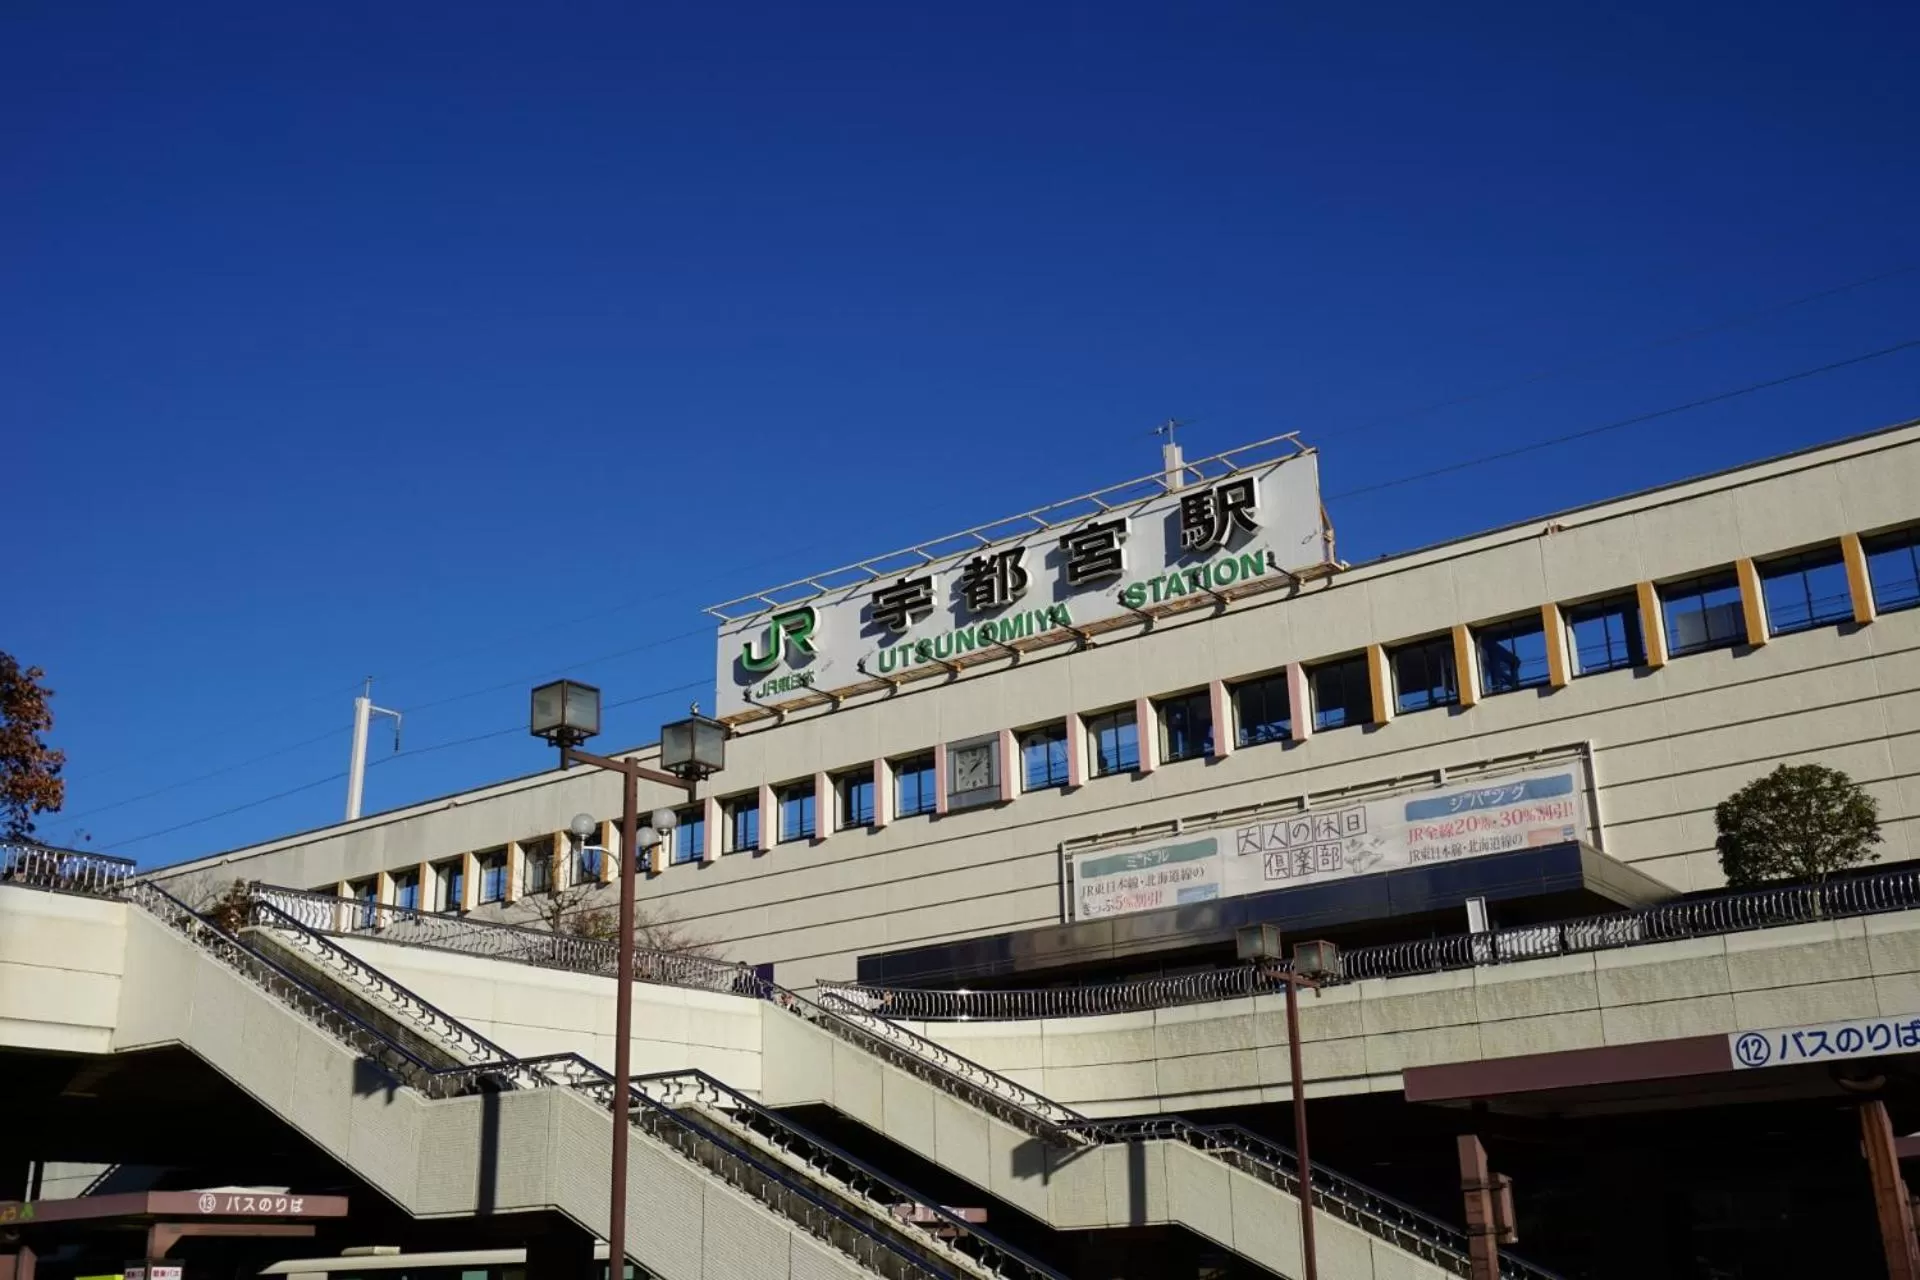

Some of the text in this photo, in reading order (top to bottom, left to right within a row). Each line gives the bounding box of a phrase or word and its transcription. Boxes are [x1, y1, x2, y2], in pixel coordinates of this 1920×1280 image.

[871, 477, 1260, 634] 宇都宮駅
[878, 548, 1268, 674] UTSUNOMIYA STATION
[742, 605, 821, 673] JR
[1449, 783, 1528, 813] ジパング
[1237, 813, 1361, 853] 大人の休日
[1264, 845, 1341, 877] 倶楽部
[1779, 1018, 1920, 1060] バスのりば
[225, 1195, 304, 1213] バスのりば
